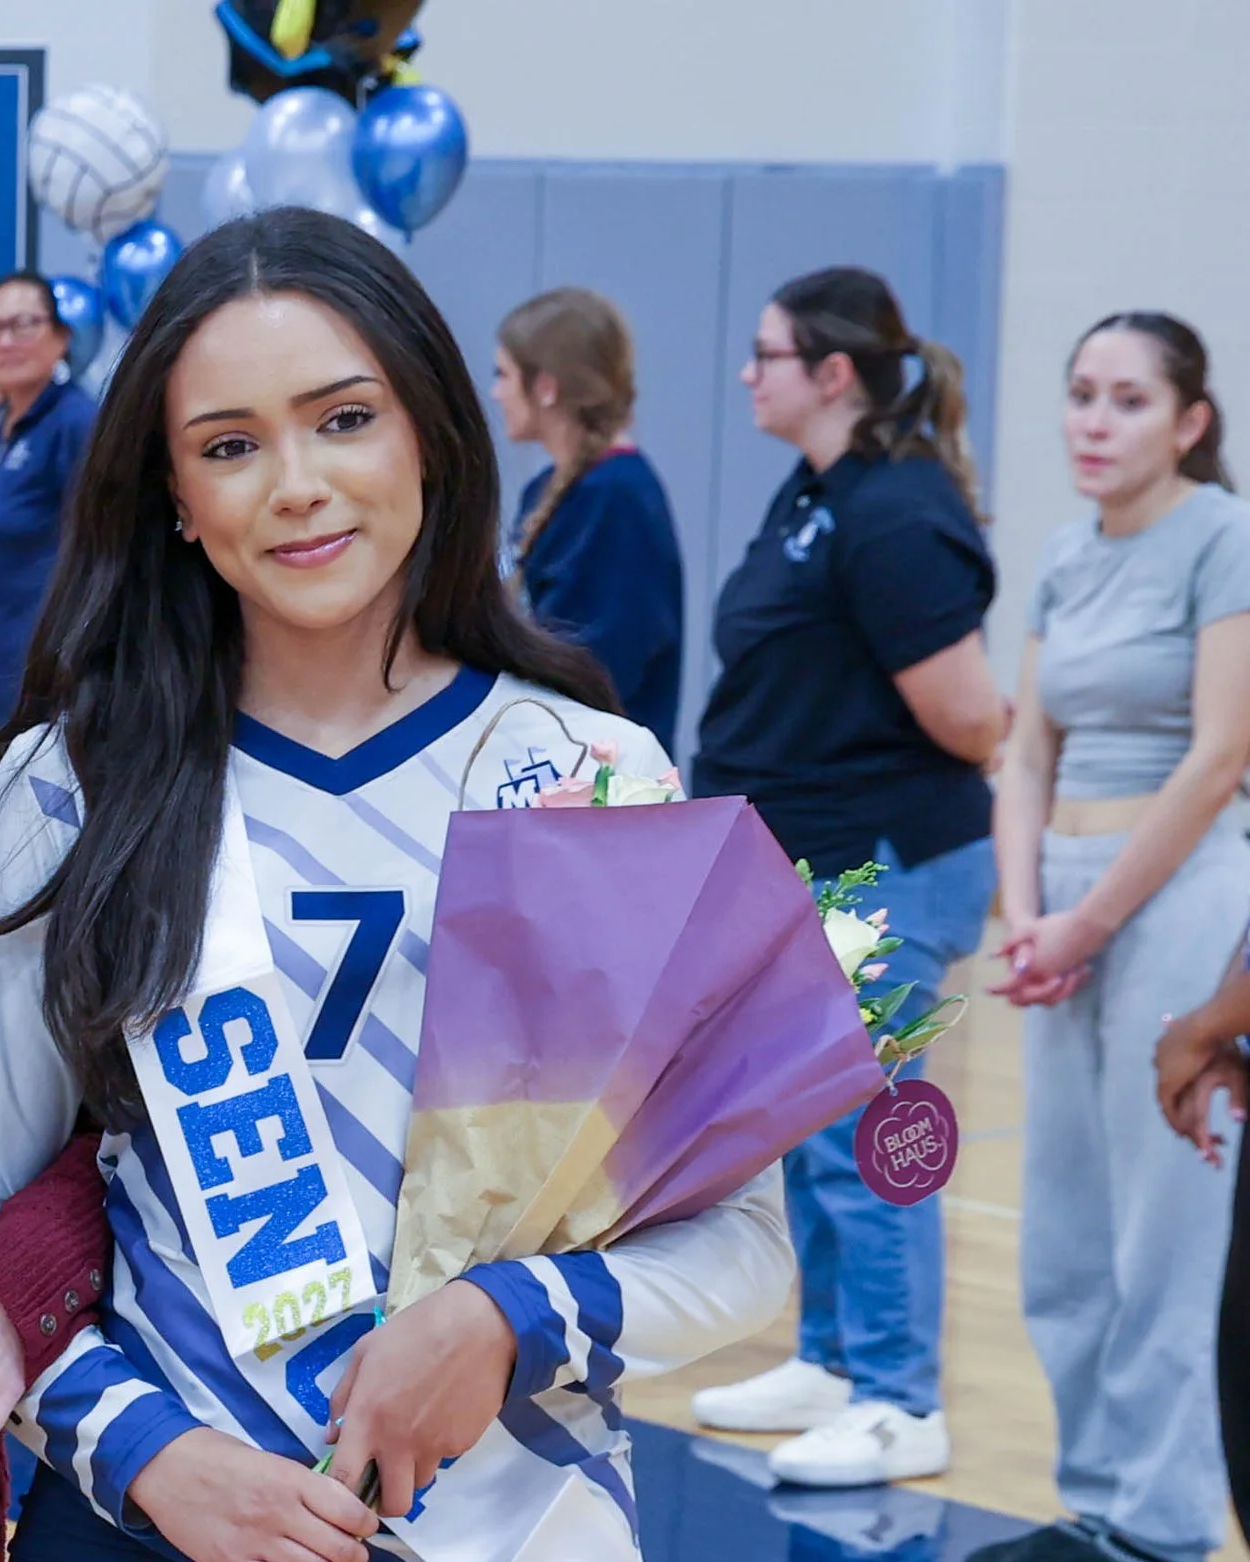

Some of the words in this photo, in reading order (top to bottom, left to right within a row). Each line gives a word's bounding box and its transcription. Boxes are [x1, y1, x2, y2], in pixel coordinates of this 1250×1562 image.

[290, 889, 406, 1061] 7
[883, 1116, 934, 1154] BLOOM
[890, 1134, 939, 1172] HAUS
[242, 1266, 353, 1363] 2027
